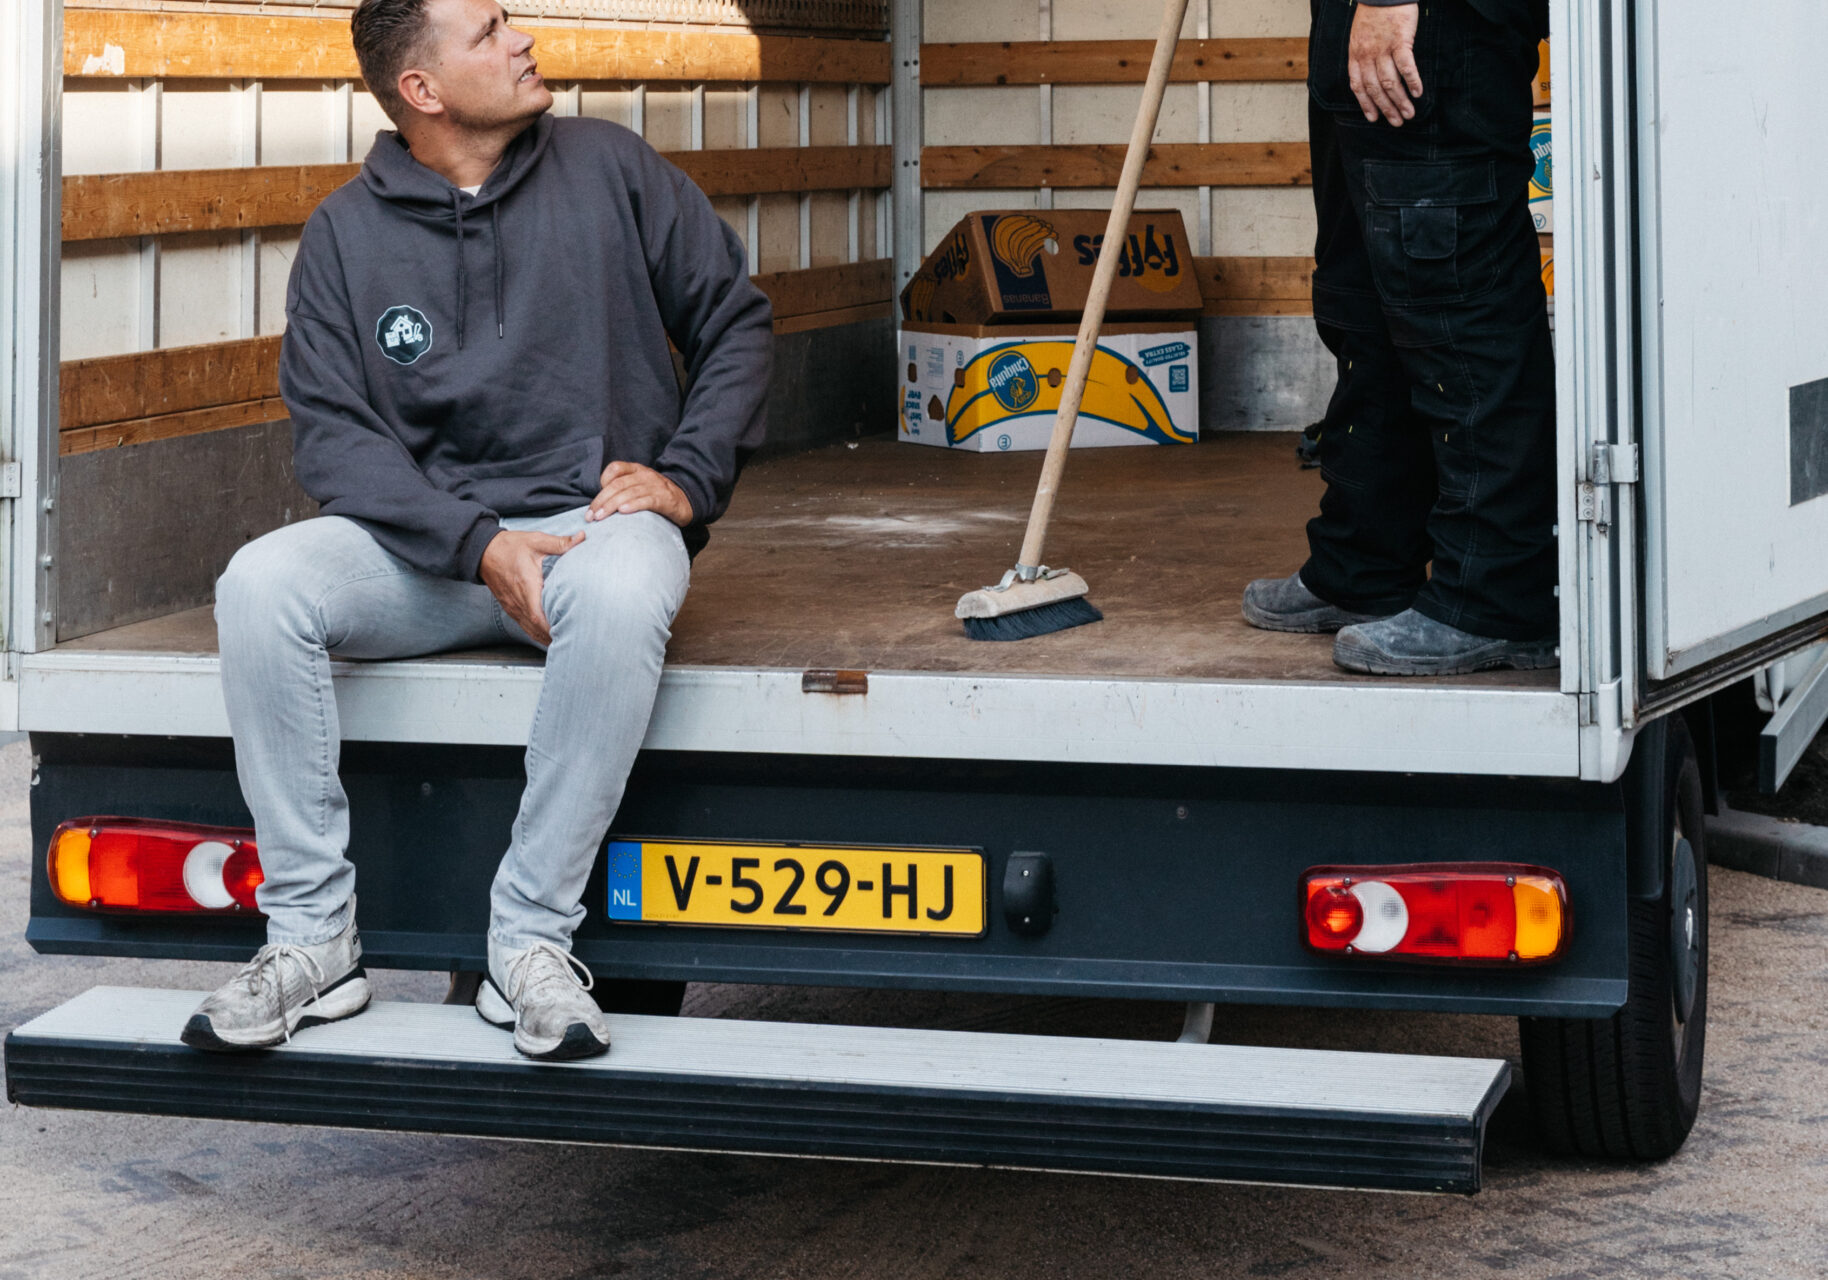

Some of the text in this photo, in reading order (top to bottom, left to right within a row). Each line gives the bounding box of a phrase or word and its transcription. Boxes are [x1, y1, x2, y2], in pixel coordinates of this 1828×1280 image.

[1003, 293, 1048, 305] Bananas
[1144, 344, 1184, 358] CLASS EXTRA
[988, 357, 1030, 392] Chiquita
[664, 854, 955, 922] V-529-HJ
[613, 889, 637, 907] NL
